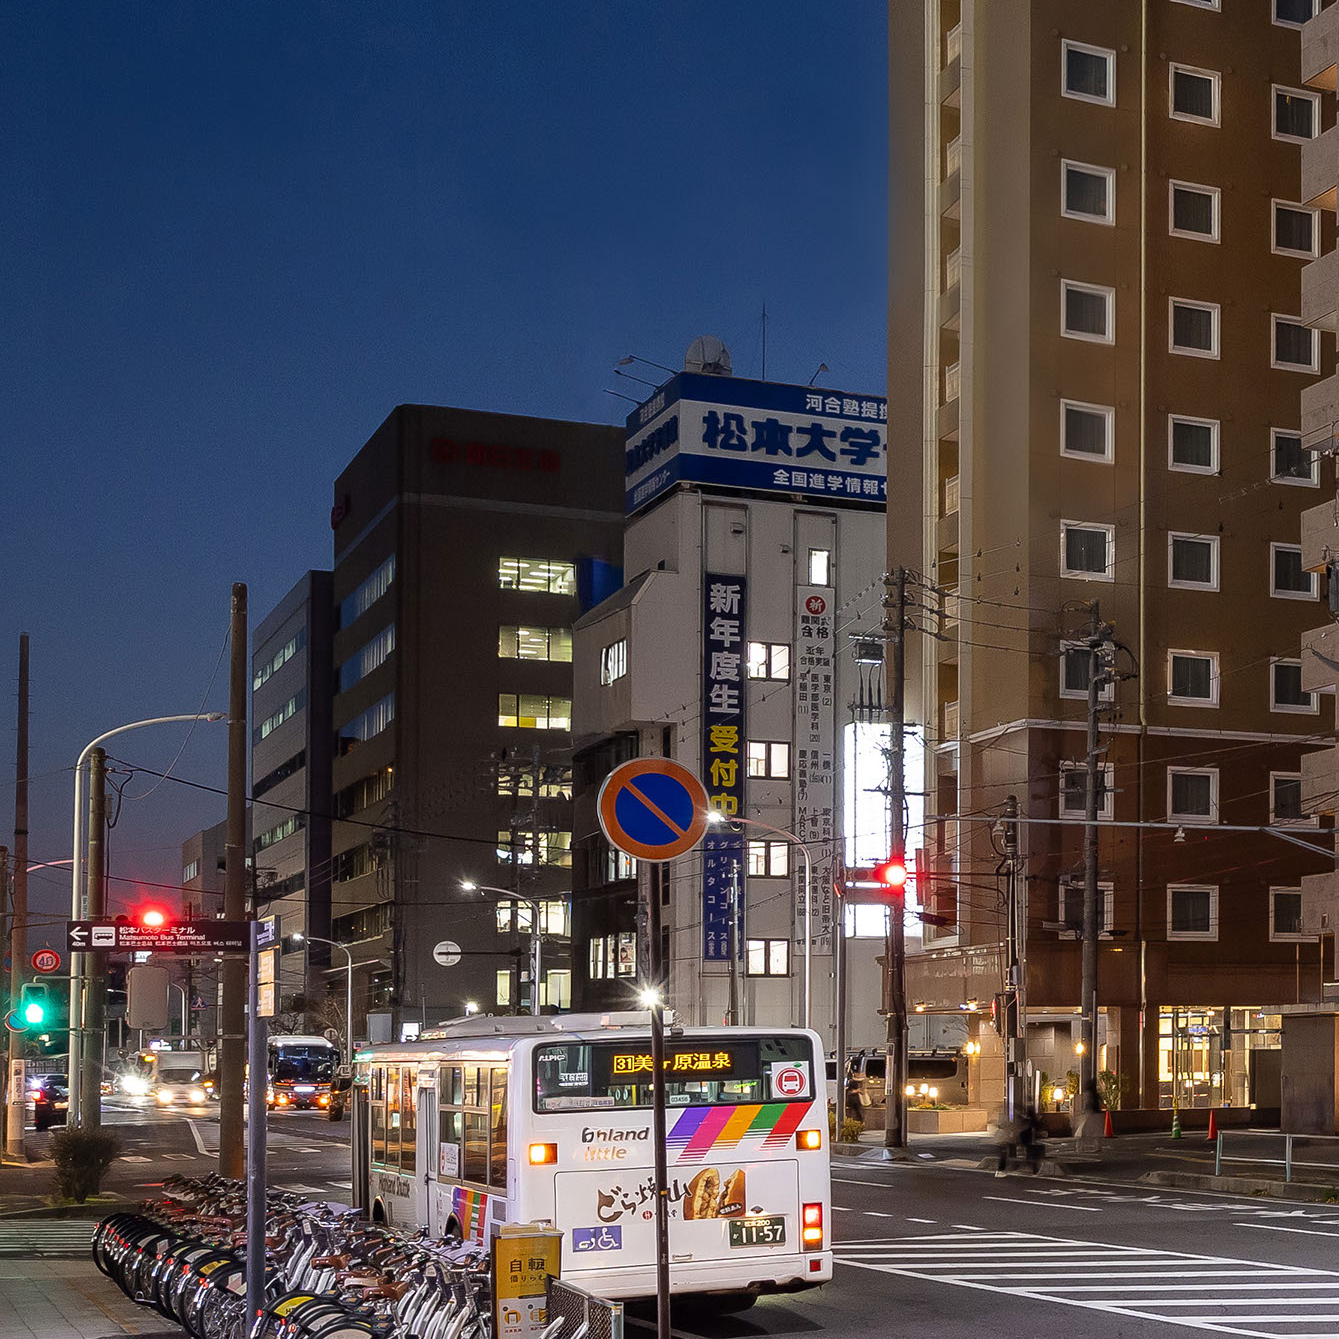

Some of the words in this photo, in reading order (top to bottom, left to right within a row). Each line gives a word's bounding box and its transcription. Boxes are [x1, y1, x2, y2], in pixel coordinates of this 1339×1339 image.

[702, 410, 887, 466] 松本大学
[801, 625, 829, 639] 合格
[742, 1226, 783, 1244] 11-57
